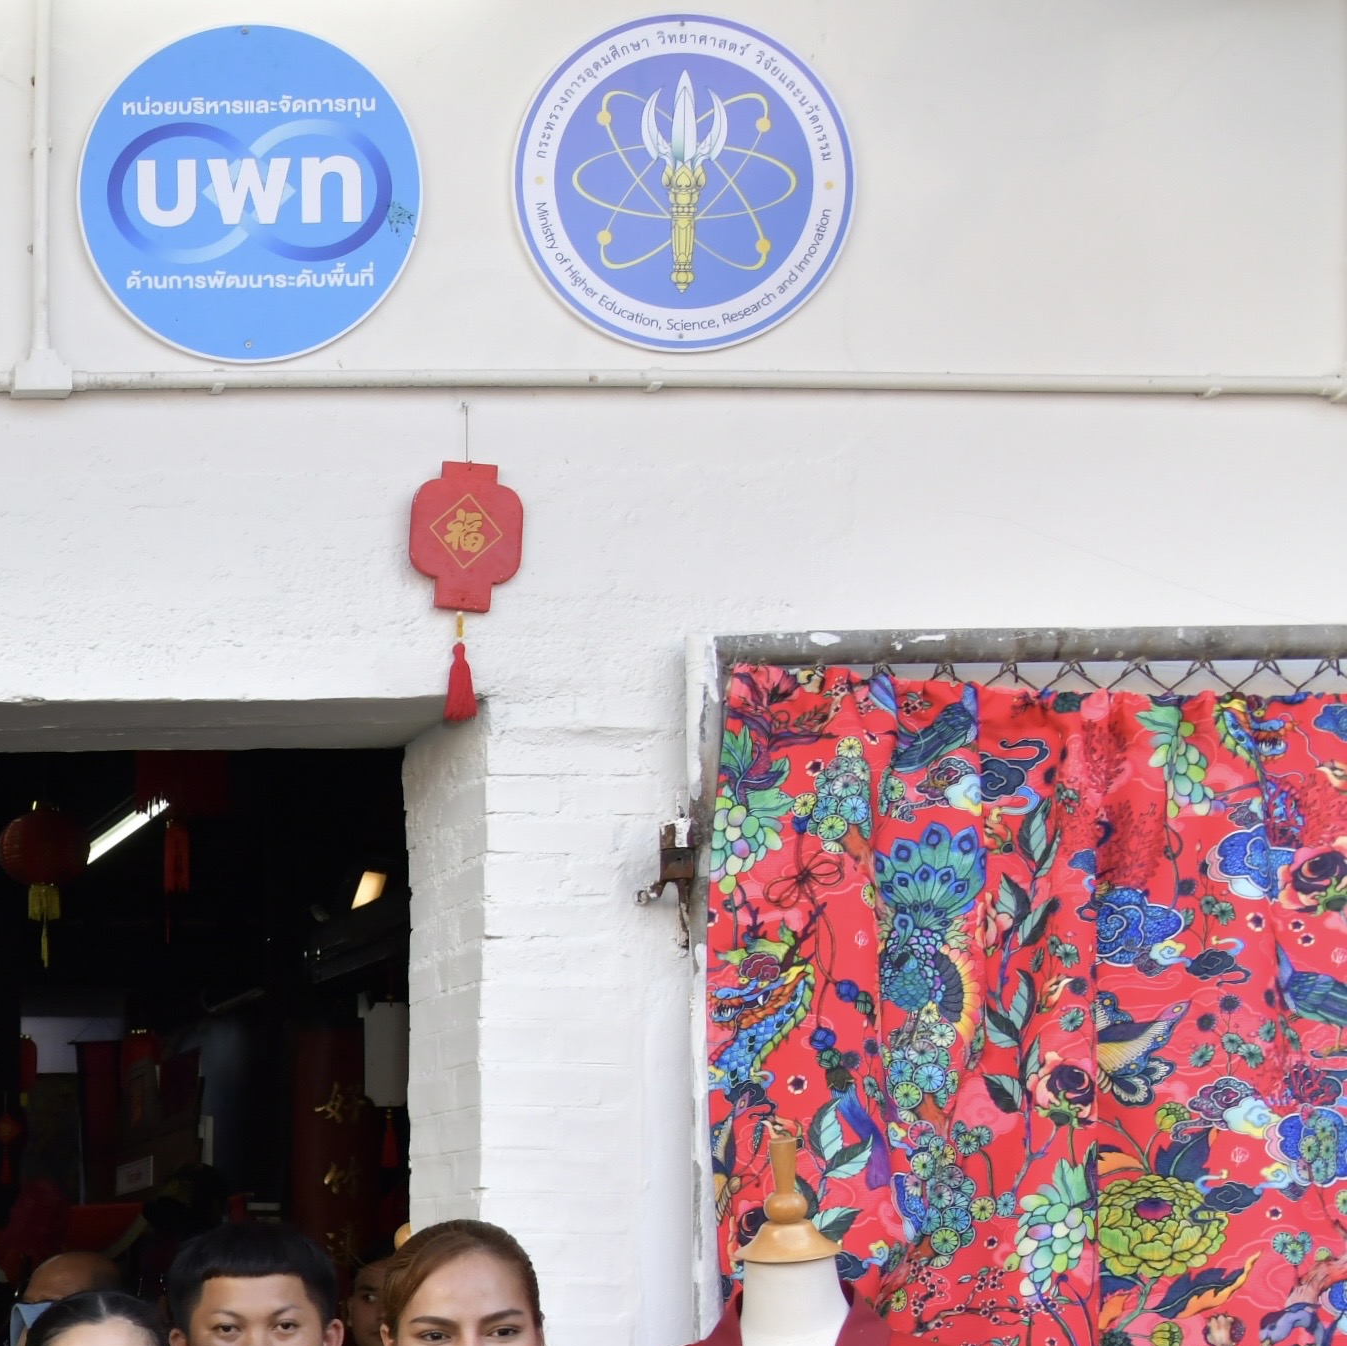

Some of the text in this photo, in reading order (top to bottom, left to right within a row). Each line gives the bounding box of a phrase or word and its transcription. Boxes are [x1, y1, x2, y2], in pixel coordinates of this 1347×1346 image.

[122, 95, 376, 118] หน่วยบริหารและจัดการทุน
[536, 30, 832, 162] กระทรวงการอุดมศึกษา วิทยาศาสตร์ วิจัยและนวัตกรรม
[126, 261, 374, 290] ด้านการพัฒนาระดับพื้นที่
[535, 201, 832, 332] Ministry of Higher Education, Science, Research and Innovation
[444, 508, 487, 554] 福
